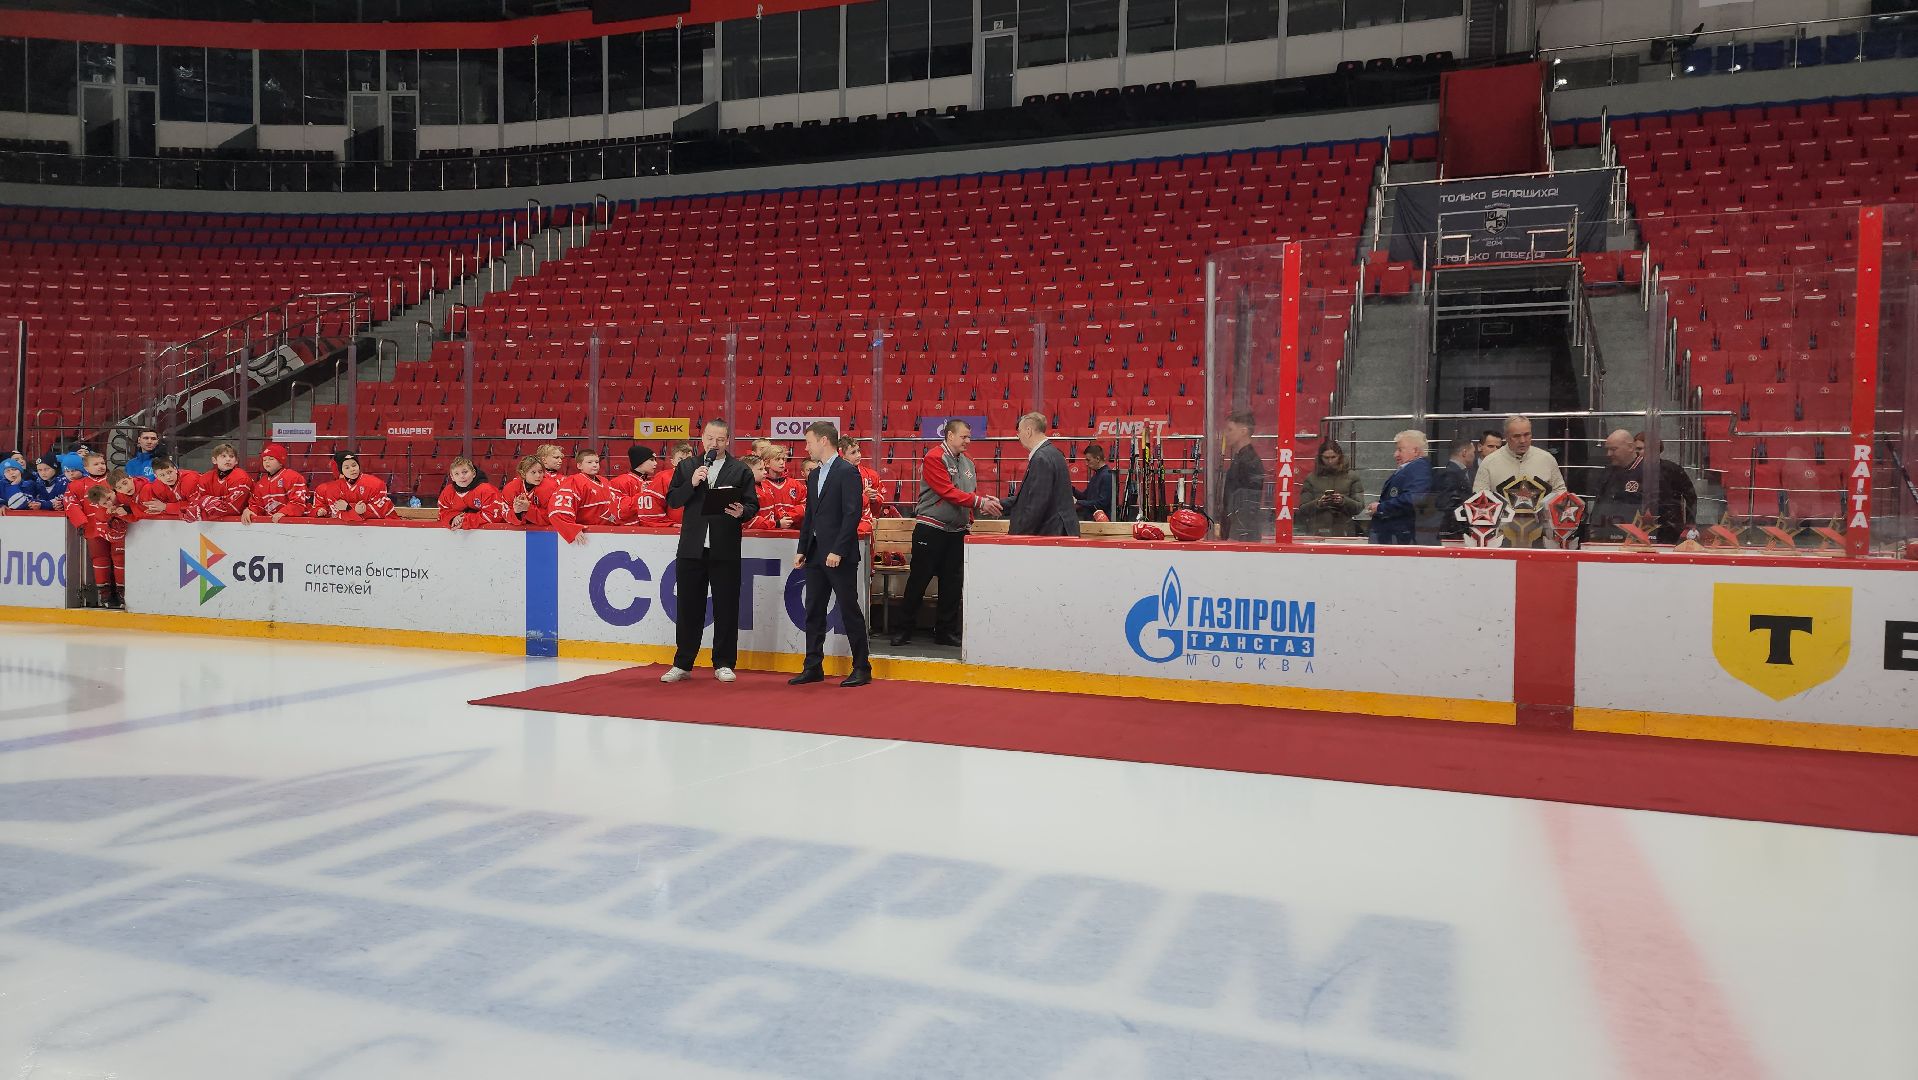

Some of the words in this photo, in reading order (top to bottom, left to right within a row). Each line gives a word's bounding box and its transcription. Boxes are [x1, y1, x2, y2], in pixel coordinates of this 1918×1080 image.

[1440, 191, 1487, 203] ТОЛЬКО
[1491, 188, 1559, 199] БАЛАШИХА!
[509, 423, 555, 435] KHL.RU
[655, 425, 684, 433] БАНК
[1276, 448, 1293, 520] RAITA
[1850, 444, 1872, 528] RAITA
[554, 494, 573, 508] 23
[638, 495, 653, 510] 90
[232, 555, 284, 583] сбп
[305, 562, 362, 577] система
[365, 561, 429, 583] быстрых
[304, 580, 372, 595] платежей
[1187, 596, 1316, 634] ГАЗПРОМ
[1190, 633, 1311, 654] ТРАНСГАЗ
[1186, 653, 1314, 674] МОСКВА
